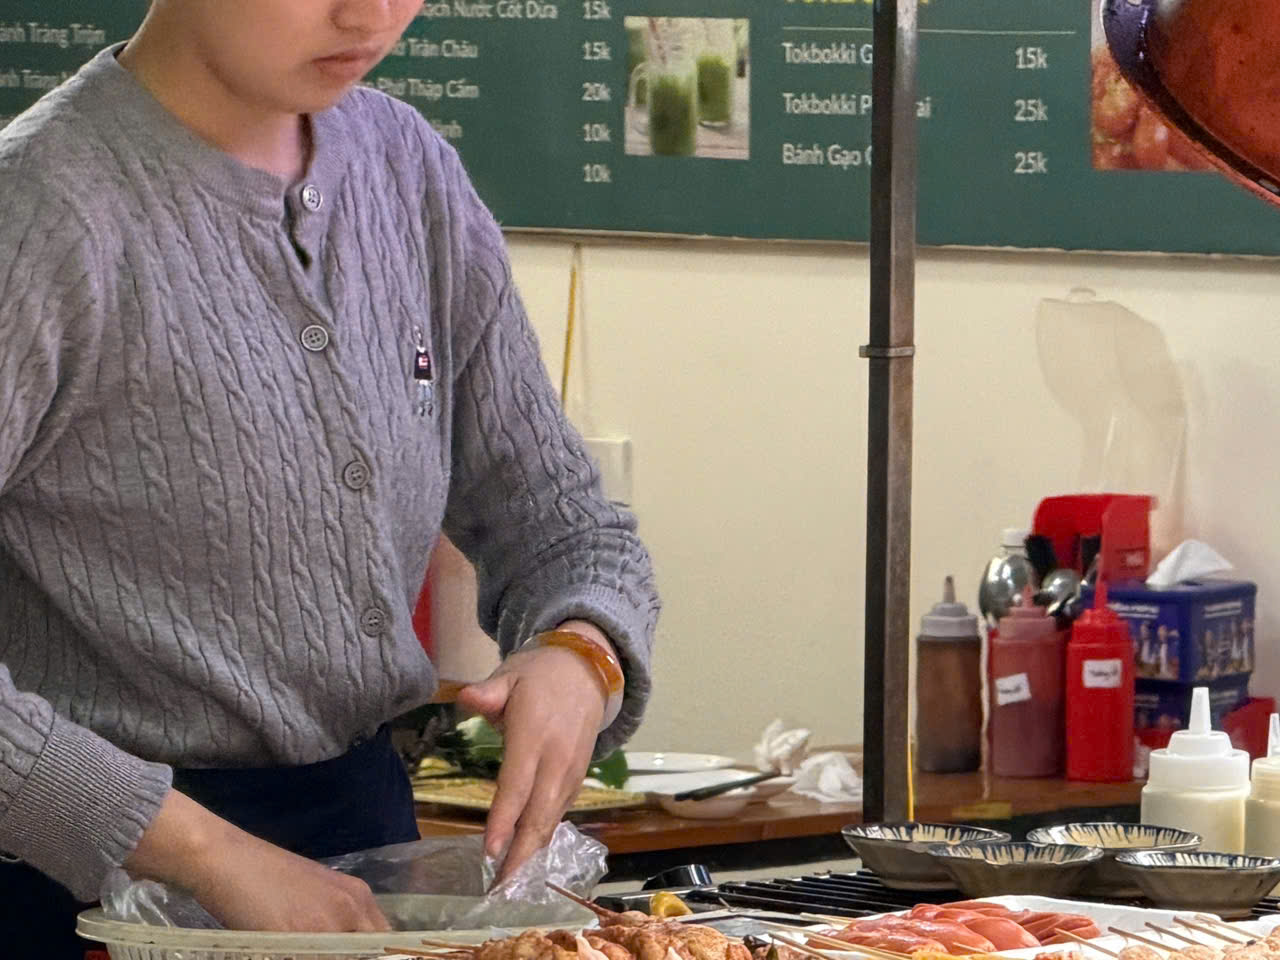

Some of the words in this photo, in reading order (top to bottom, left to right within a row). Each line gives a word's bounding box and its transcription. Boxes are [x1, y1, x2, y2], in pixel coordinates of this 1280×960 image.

[583, 1, 612, 20] 15k
[583, 41, 612, 60] 15k
[781, 41, 856, 64] Tokbokki
[1015, 47, 1048, 69] 15k
[582, 82, 612, 101] 20k
[781, 92, 856, 115] Tokbokki
[916, 96, 932, 118] ai
[1014, 99, 1048, 121] 25k
[583, 123, 612, 142] 10k
[781, 143, 823, 165] Bánh
[827, 144, 862, 169] Gạo
[1014, 152, 1048, 174] 25k
[583, 164, 612, 183] 10k
